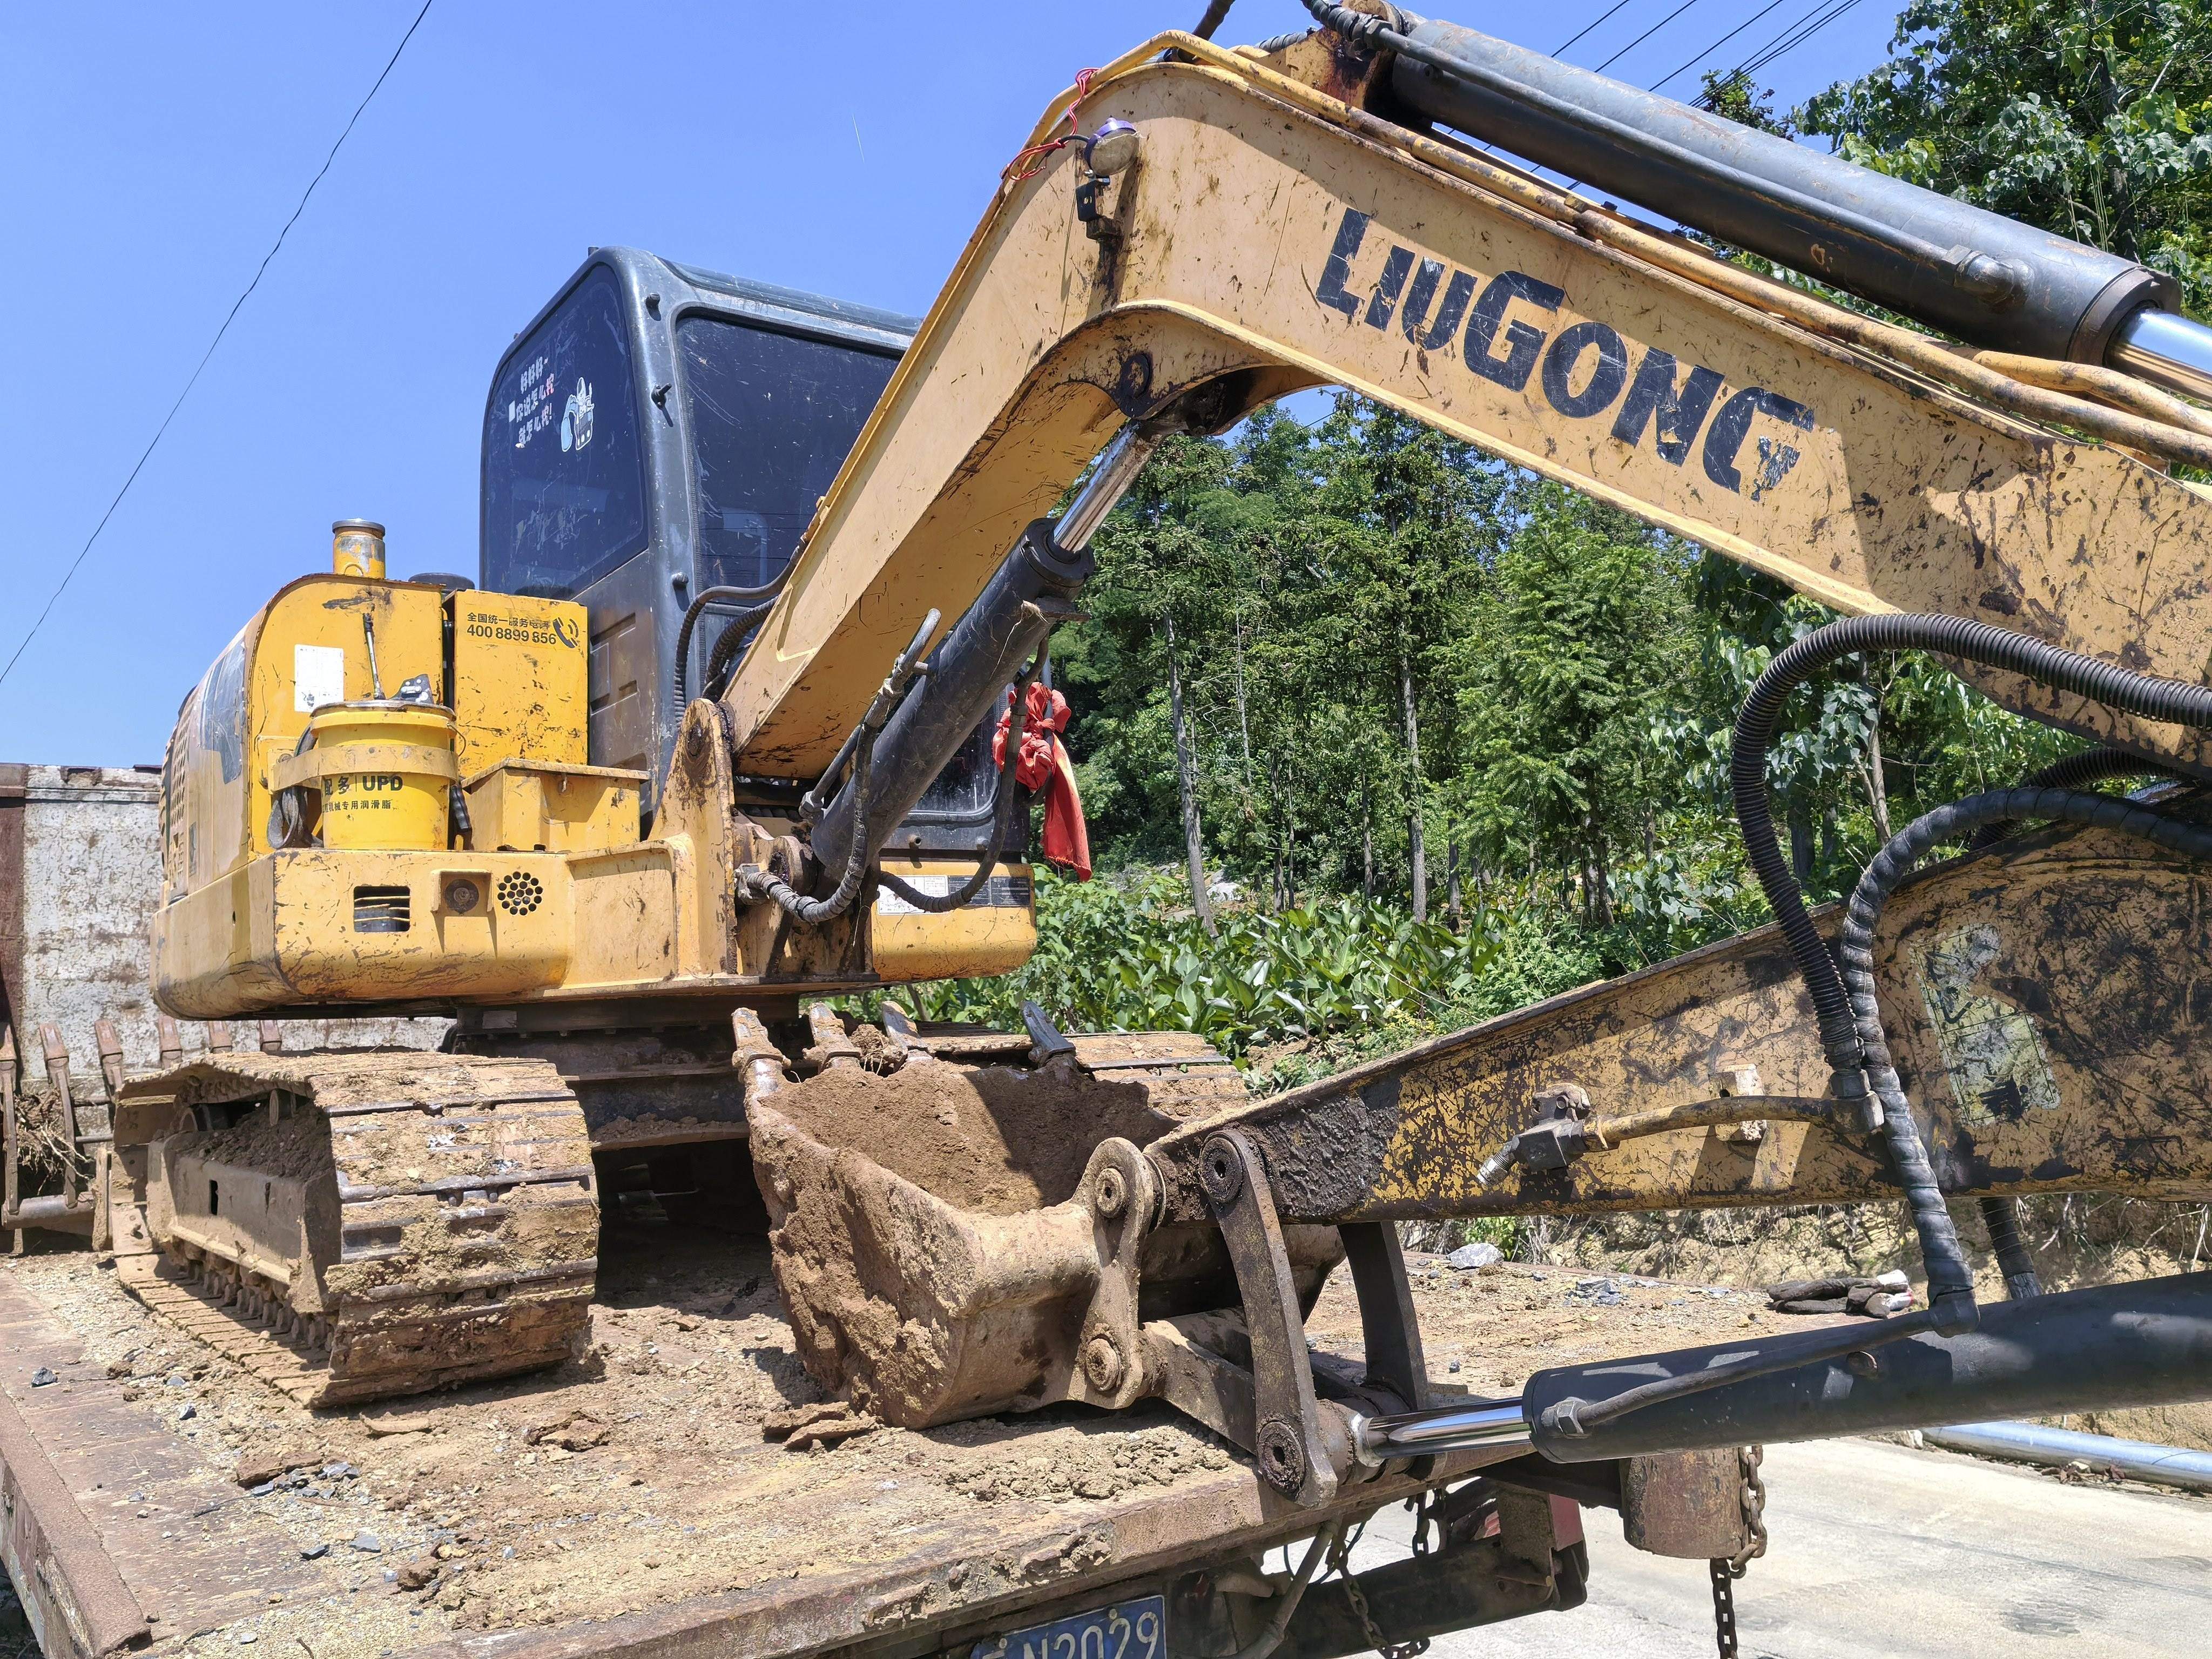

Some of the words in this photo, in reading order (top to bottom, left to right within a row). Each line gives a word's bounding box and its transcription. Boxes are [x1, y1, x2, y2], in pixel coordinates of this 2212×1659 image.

[1316, 206, 1814, 502] LIUGONG
[467, 624, 493, 638] 400
[495, 627, 529, 642] 8899
[362, 775, 403, 791] UPD
